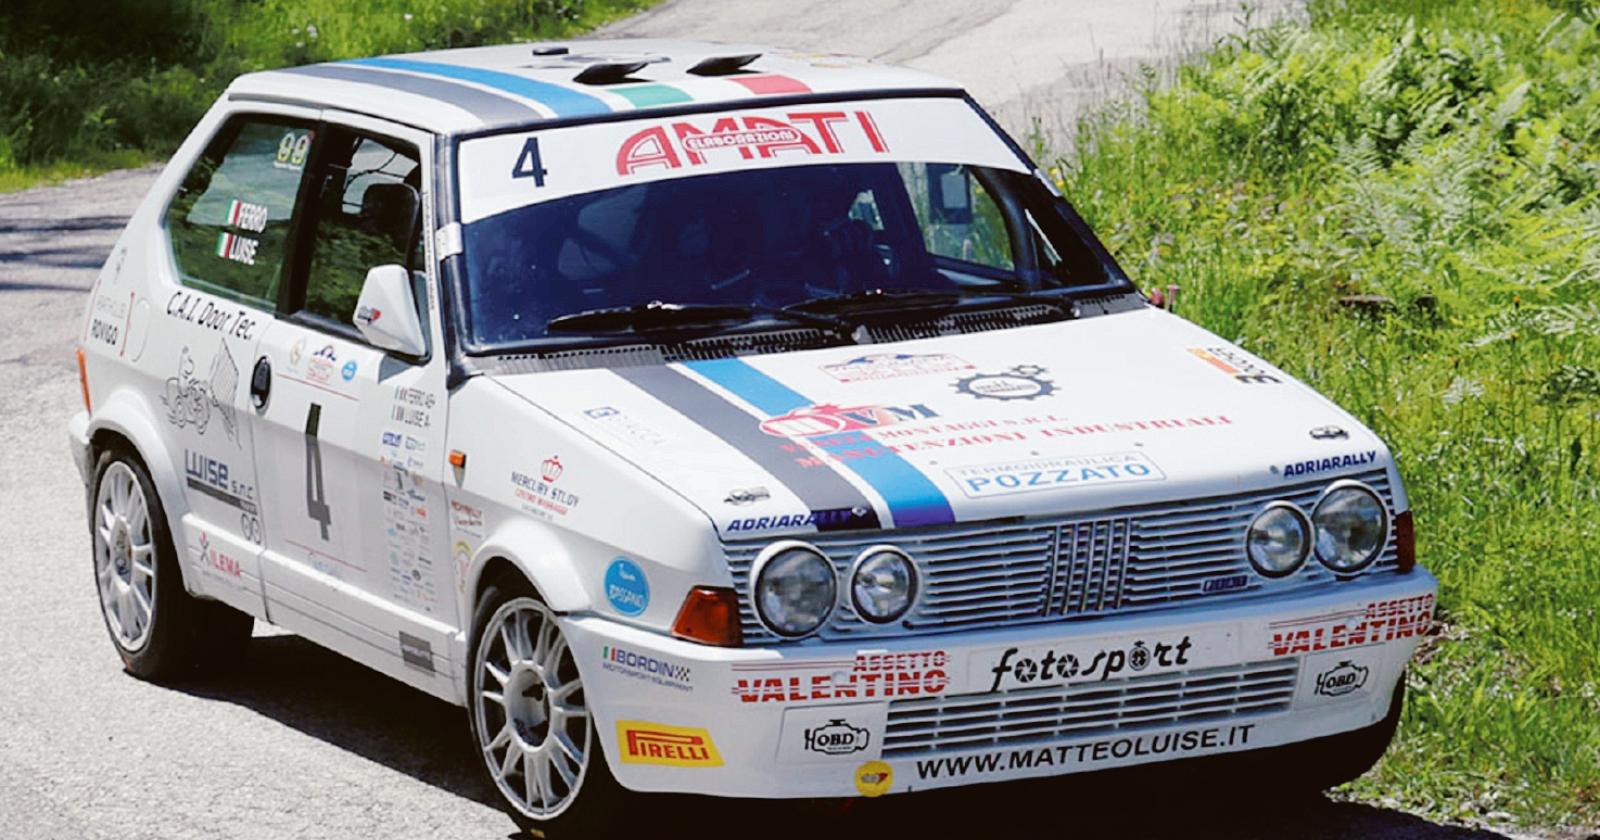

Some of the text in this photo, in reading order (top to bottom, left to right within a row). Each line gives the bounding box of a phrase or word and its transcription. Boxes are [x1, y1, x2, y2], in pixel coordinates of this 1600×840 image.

[616, 109, 891, 176] AMATI
[688, 129, 796, 151] ELABORAZIONI
[511, 136, 548, 188] 4
[237, 200, 268, 234] FERRO
[229, 233, 260, 266] LUISE
[198, 301, 232, 332] Door
[794, 414, 1233, 468] MANUTENZIONI INDUSTRIALI
[305, 402, 332, 542] 4
[959, 453, 1138, 477] TERMOIDRAULICA
[966, 463, 1151, 492] POZZATO
[1283, 450, 1376, 478] ADRIARALLY
[727, 508, 852, 532] ADRIARALLY
[1364, 592, 1435, 620] ASSETTO
[1273, 610, 1434, 657] VALENTINO
[616, 649, 675, 678] BORDIN
[853, 649, 947, 672] ASSETTO
[991, 635, 1193, 693] fotosport
[737, 669, 947, 703] VALENTINO
[626, 729, 710, 760] PIRELLI
[916, 723, 1257, 781] WWW.MATTEOLUISE.IT
